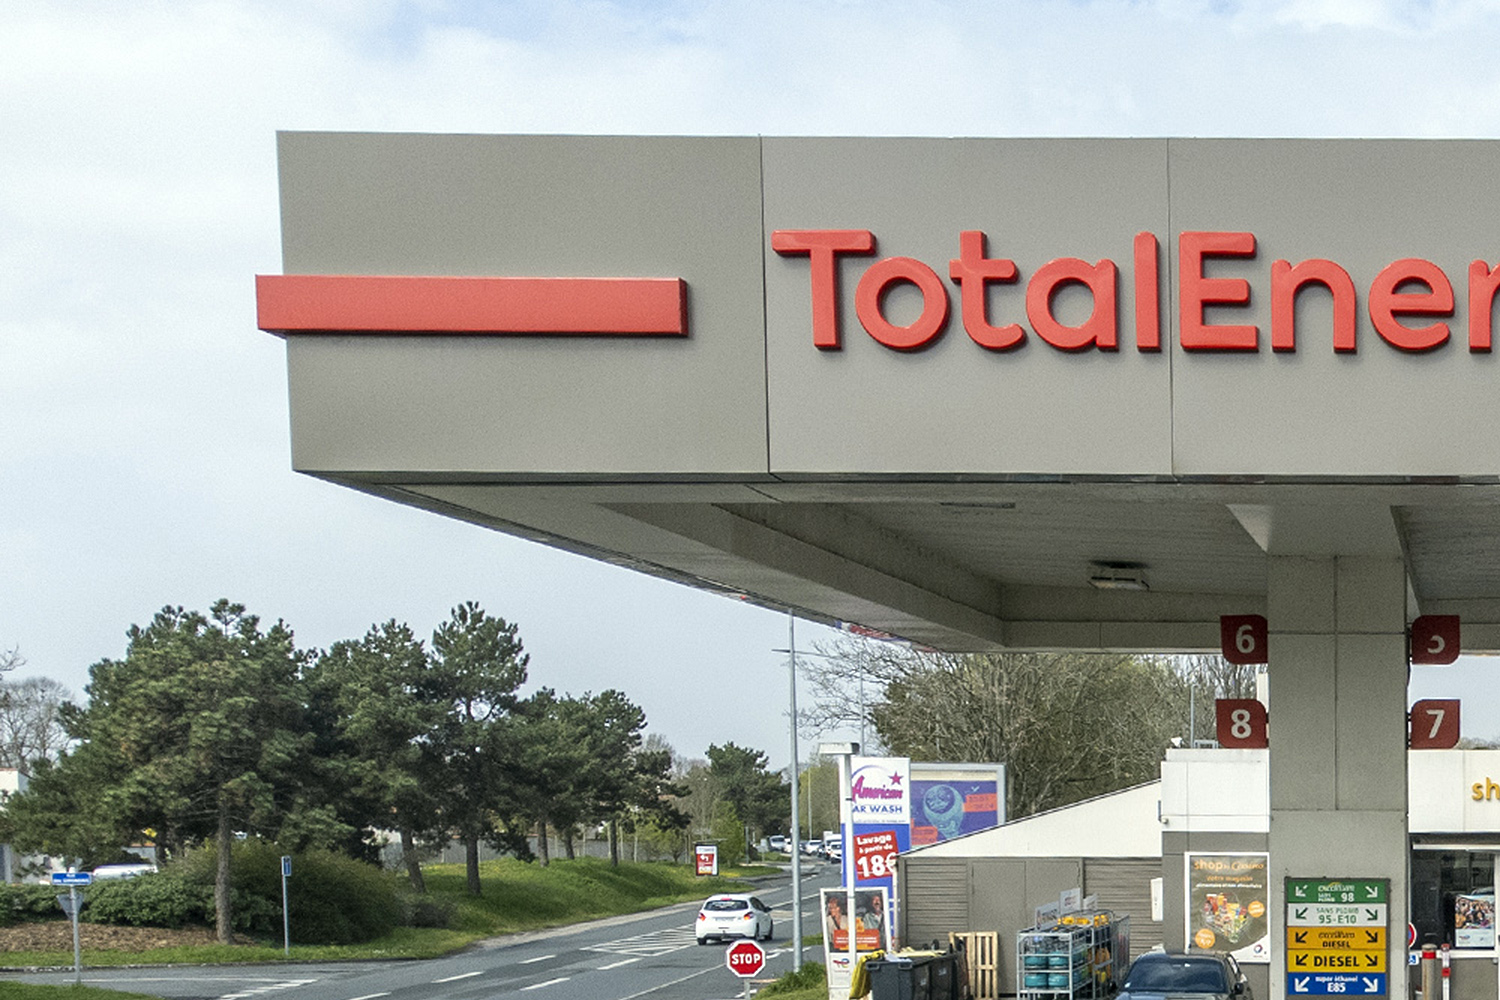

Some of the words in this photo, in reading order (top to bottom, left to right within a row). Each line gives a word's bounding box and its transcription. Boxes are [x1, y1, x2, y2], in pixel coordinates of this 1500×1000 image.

[1235, 624, 1256, 654] 6
[1230, 709, 1252, 739] 8
[1426, 709, 1446, 739] 7
[851, 805, 868, 814] AR
[869, 804, 903, 814] WASH
[857, 834, 892, 847] Lavage
[857, 851, 897, 878] 18€
[1194, 859, 1223, 873] shop
[1341, 892, 1355, 902] 98
[1318, 914, 1357, 924] 95-E10
[1322, 940, 1351, 948] DIESEL
[731, 953, 761, 965] STOP
[1313, 955, 1360, 967] DIESEL
[1327, 982, 1346, 993] E85
